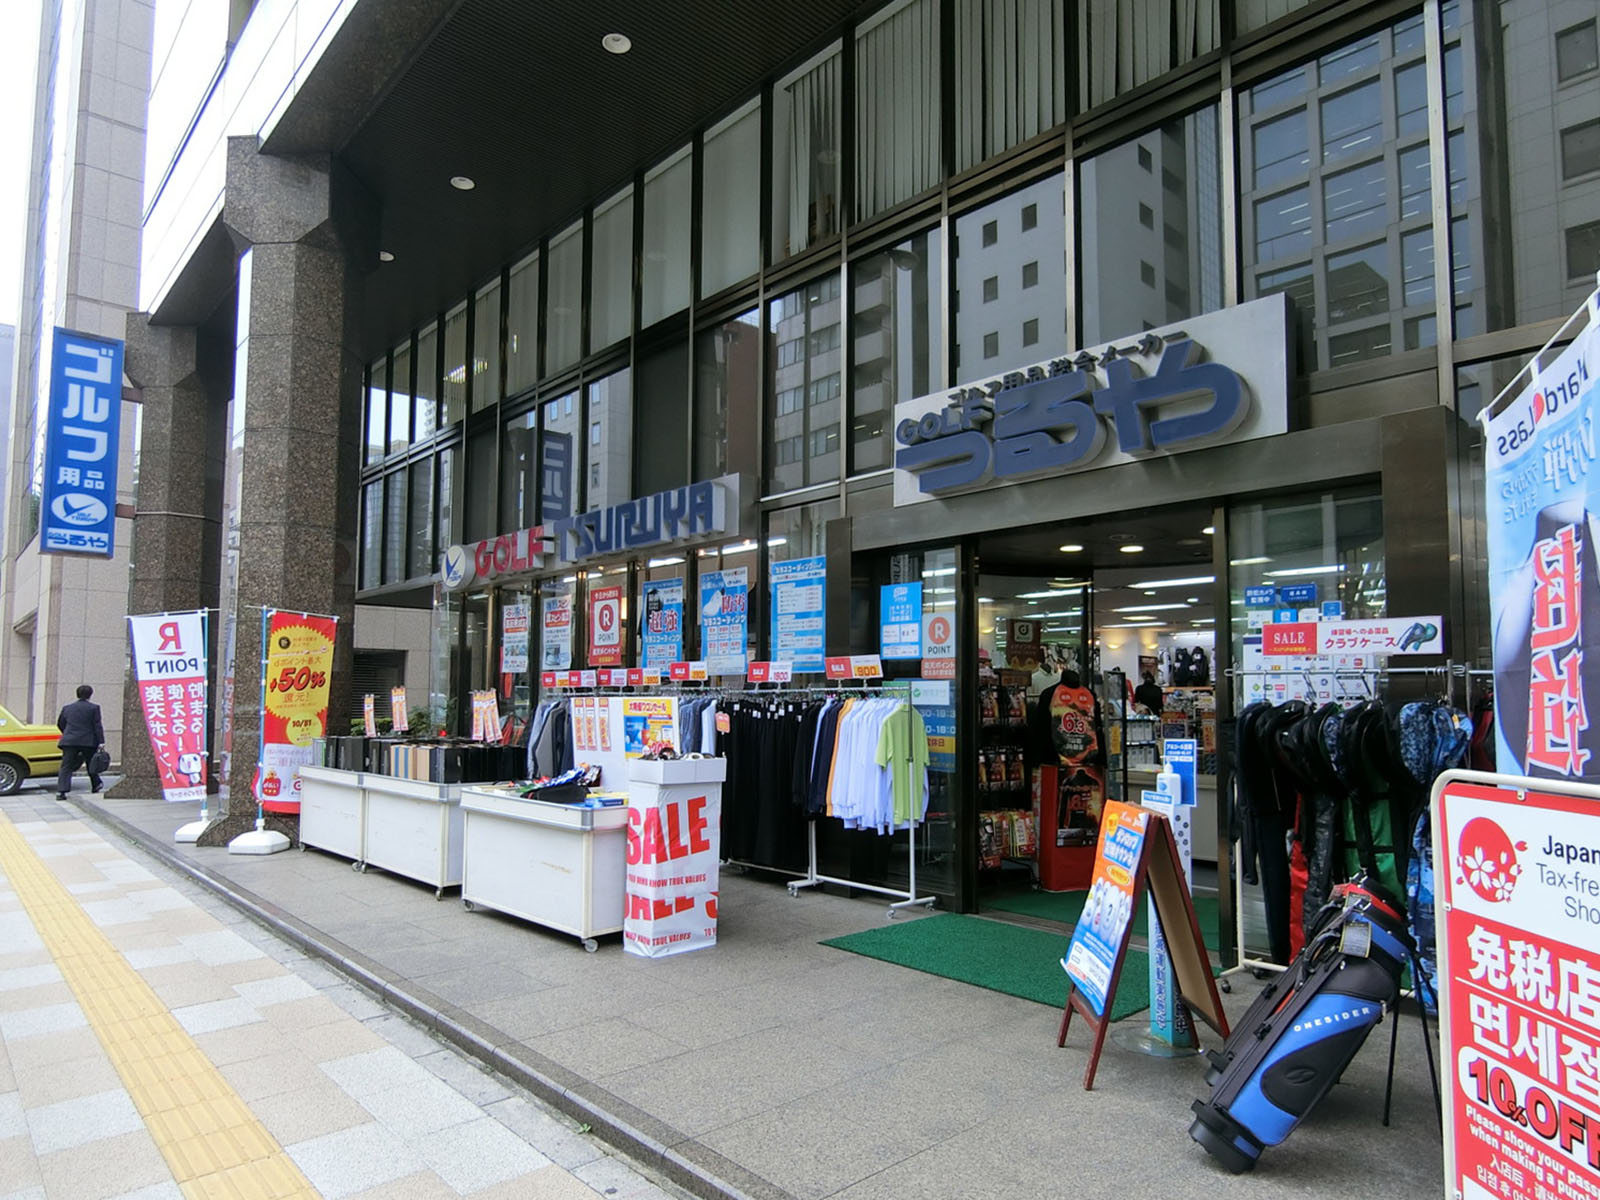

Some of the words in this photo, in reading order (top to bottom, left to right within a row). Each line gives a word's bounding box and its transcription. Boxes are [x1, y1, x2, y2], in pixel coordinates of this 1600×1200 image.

[62, 343, 113, 462] ゴルフ
[896, 339, 1246, 493] つるや
[896, 399, 993, 446] GOLF
[57, 466, 104, 490] 用品
[553, 481, 714, 562] TSURUYA
[47, 533, 107, 548] つるや
[475, 525, 545, 577] GOLF
[928, 646, 951, 655] POINT
[1273, 632, 1305, 644] SALE
[1325, 636, 1397, 650] クラブケース
[626, 796, 711, 866] SALE
[649, 879, 667, 888] KNOW
[669, 876, 684, 886] TRUE
[685, 873, 706, 884] VALUES
[652, 936, 667, 946] TRUE
[669, 932, 692, 942] VALUES
[1294, 1007, 1370, 1032] ONESIDER
[1466, 1104, 1502, 1136] Please
[1504, 1130, 1534, 1156] show
[1537, 1150, 1566, 1176] your
[1470, 1124, 1500, 1149] when
[1502, 1144, 1543, 1181] making
[1546, 1172, 1555, 1187] a
